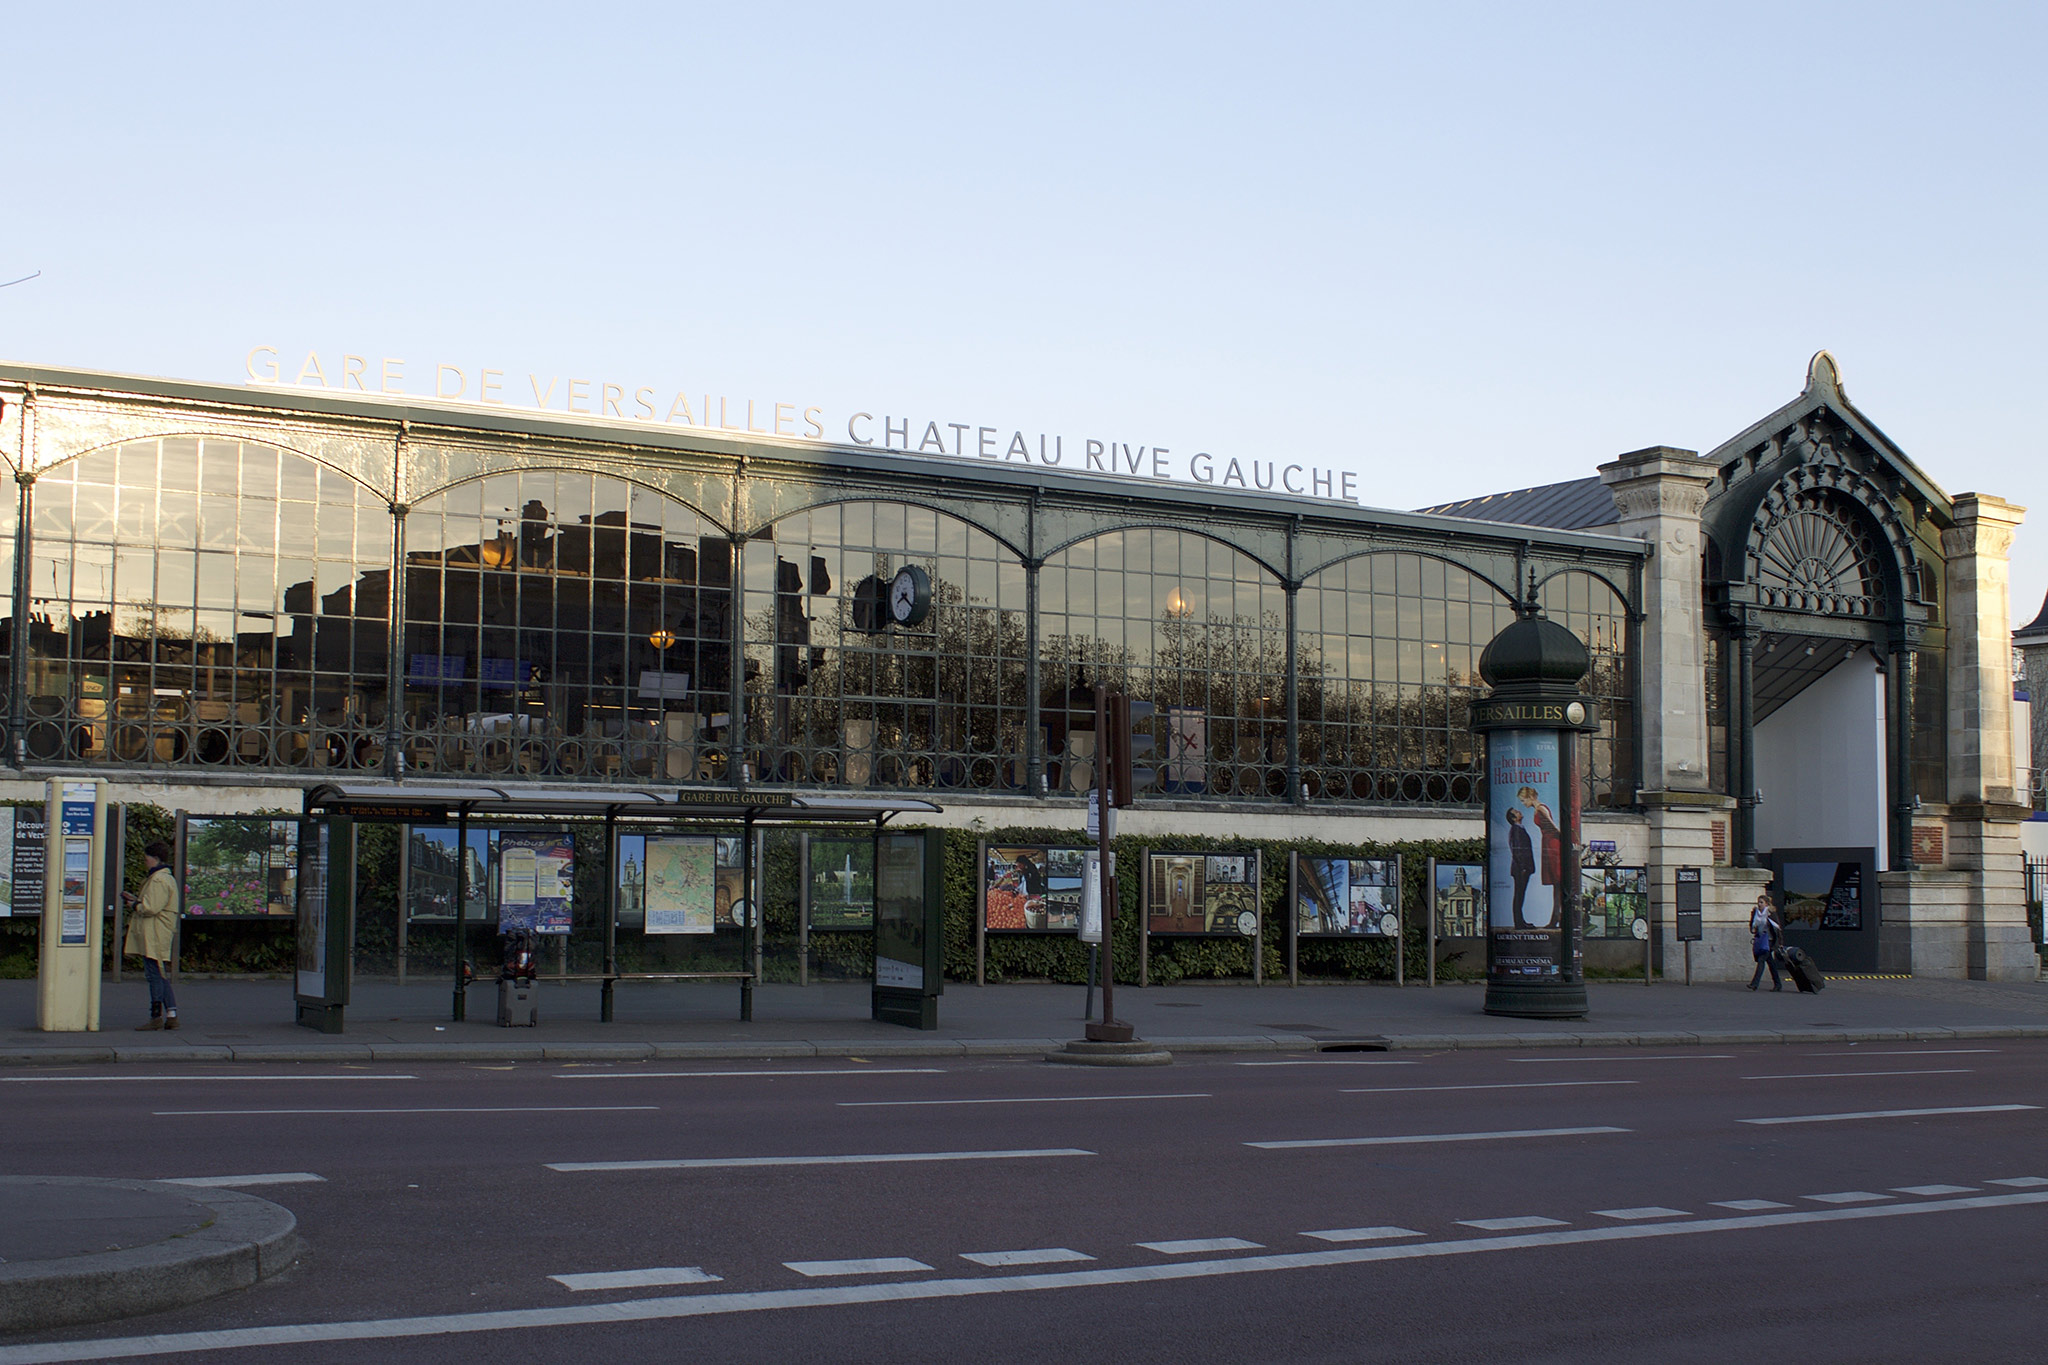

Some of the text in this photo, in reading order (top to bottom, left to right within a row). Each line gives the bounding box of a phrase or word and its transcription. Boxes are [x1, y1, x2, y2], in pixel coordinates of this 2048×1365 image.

[246, 345, 1359, 500] GARE DE VERSAILLES CHATEAU RIVE GAUCHE
[1473, 705, 1563, 721] VERSAILLES
[1502, 755, 1543, 768] homme
[682, 792, 786, 805] GARE RIVE GAUCHE
